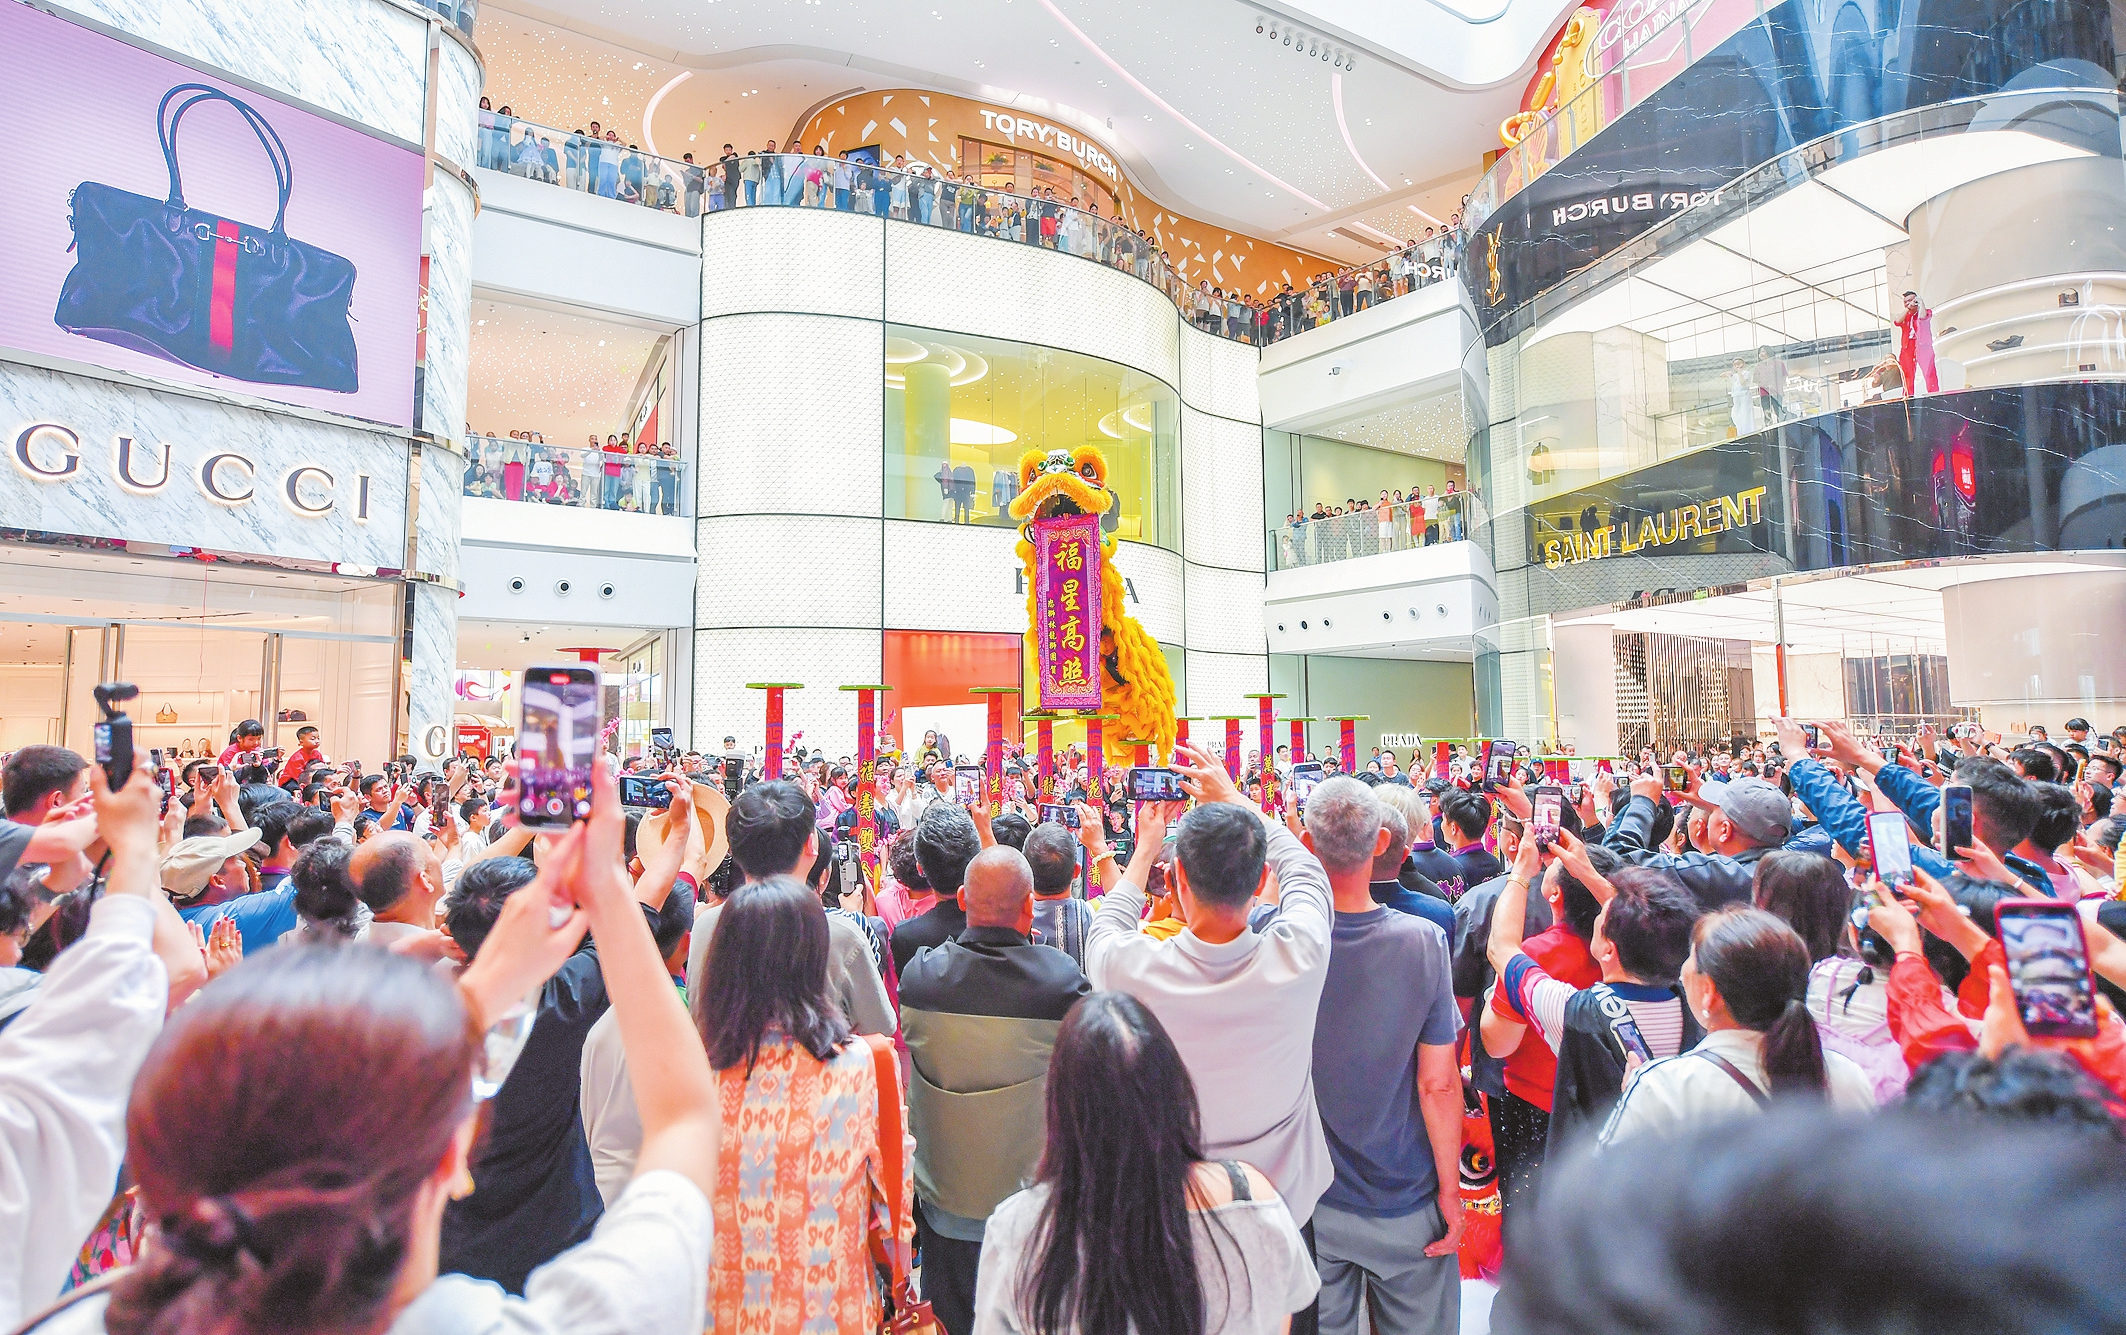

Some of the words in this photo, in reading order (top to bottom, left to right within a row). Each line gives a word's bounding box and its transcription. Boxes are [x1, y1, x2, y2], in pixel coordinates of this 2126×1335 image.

[979, 109, 1051, 143] TORY
[1057, 131, 1117, 183] BURCH
[14, 422, 371, 520] GUCCI
[1544, 525, 1616, 570] SAINT
[1620, 485, 1767, 554] LAURENT
[1053, 541, 1086, 687] 福星高照
[1381, 734, 1422, 747] PRADA
